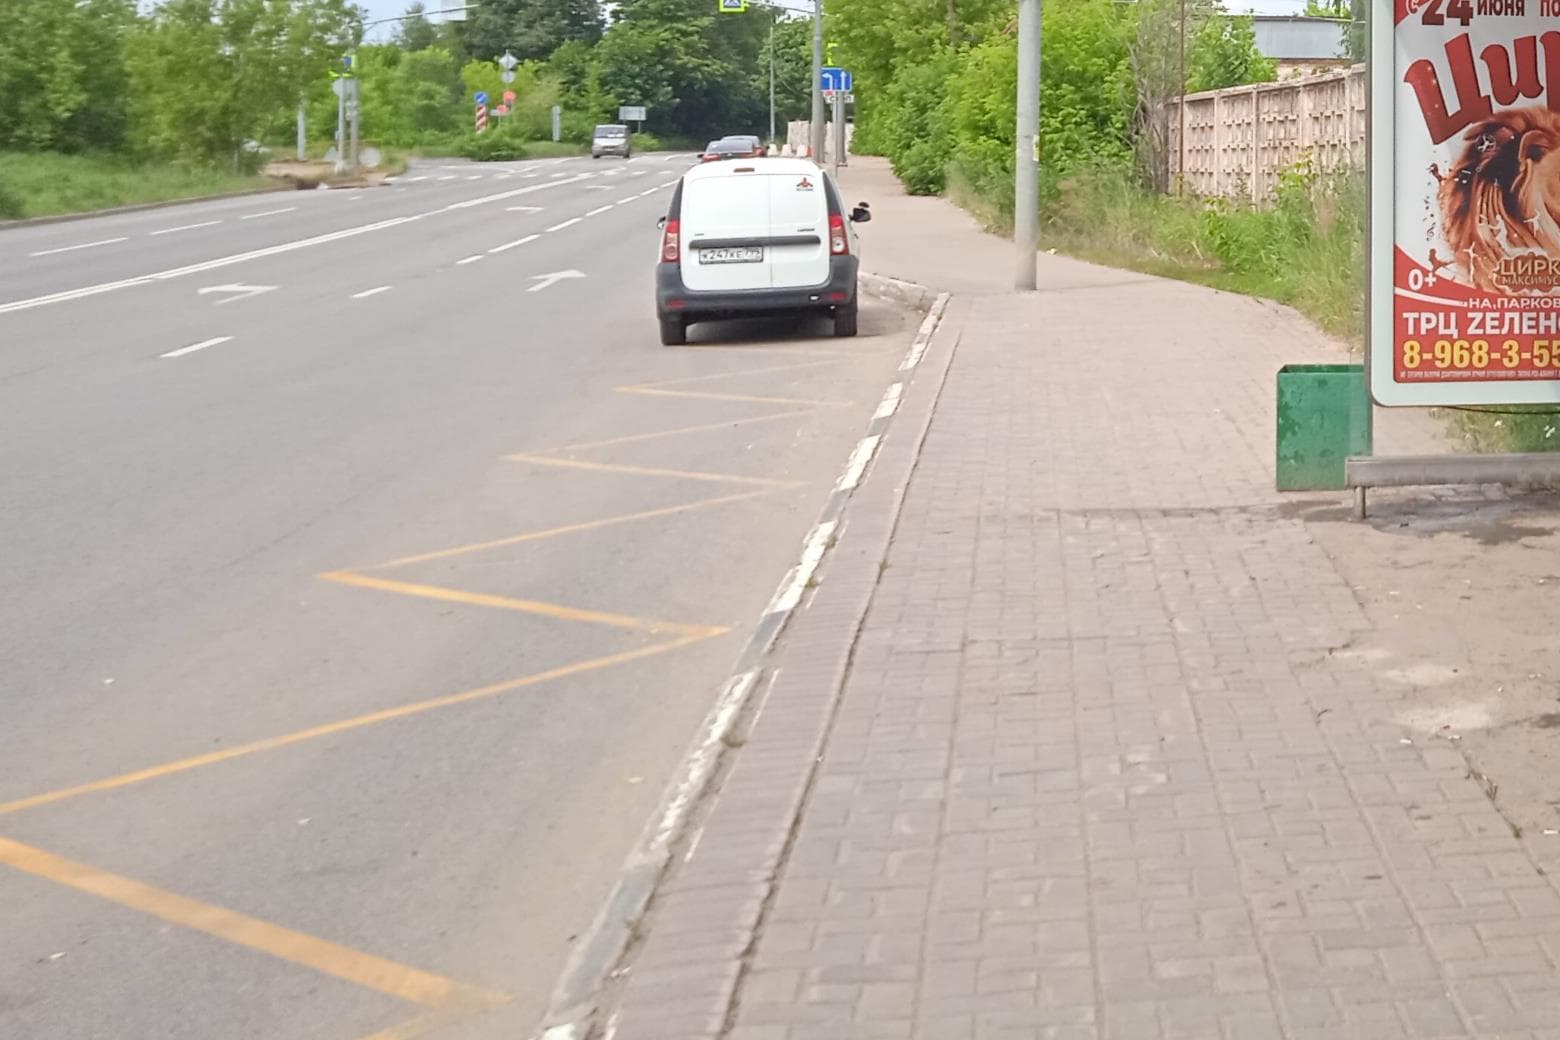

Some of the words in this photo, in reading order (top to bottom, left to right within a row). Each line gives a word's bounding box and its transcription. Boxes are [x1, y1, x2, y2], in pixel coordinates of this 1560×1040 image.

[1500, 259, 1560, 279] ЦИРК
[1408, 269, 1437, 291] 0+
[1502, 276, 1560, 285] МАКСИМУС
[1403, 312, 1458, 338] ТРЦ
